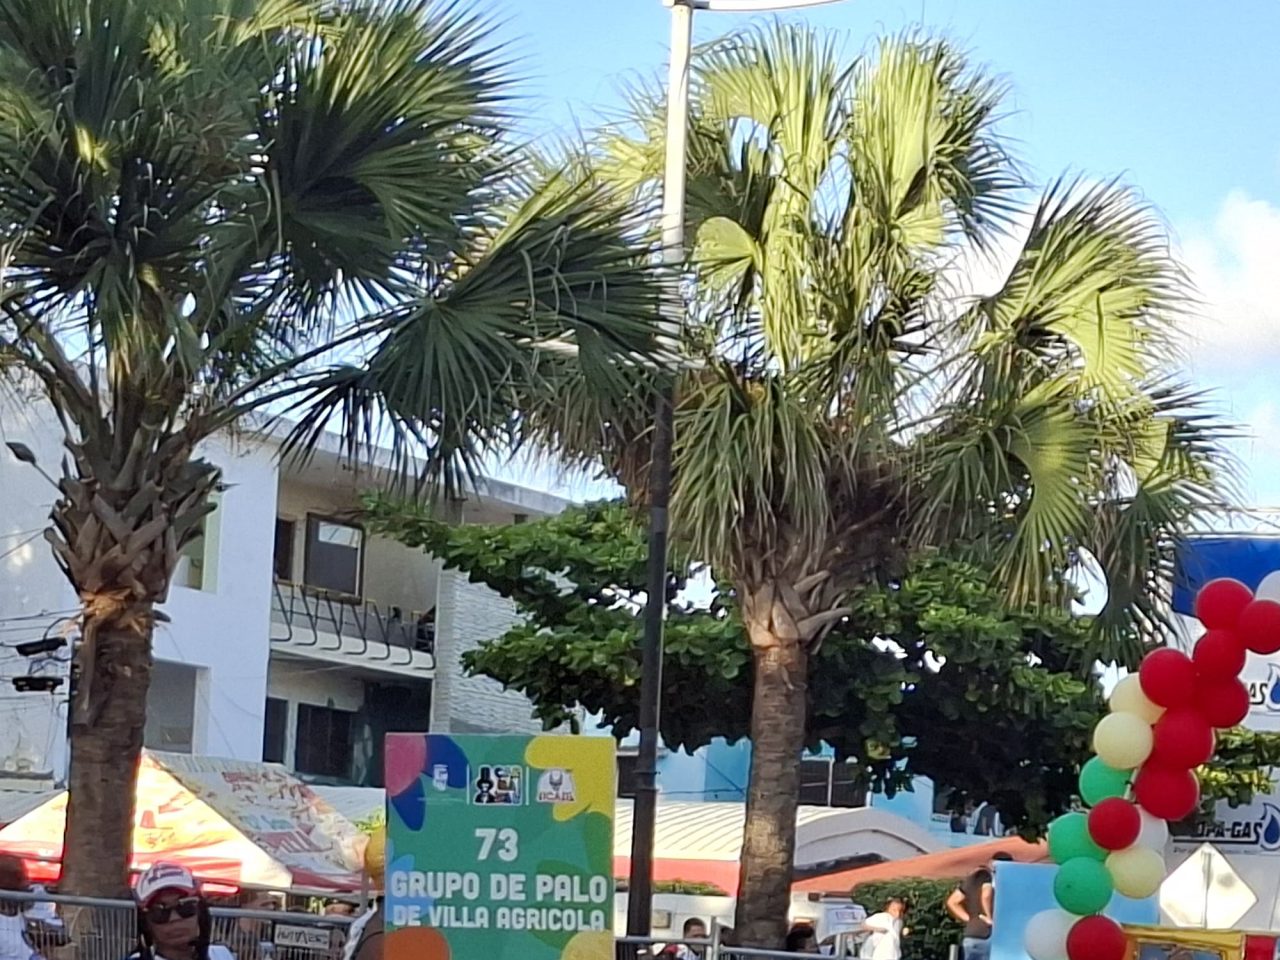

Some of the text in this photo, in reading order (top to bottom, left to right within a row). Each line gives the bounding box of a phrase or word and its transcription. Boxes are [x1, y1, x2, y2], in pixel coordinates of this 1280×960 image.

[475, 828, 519, 862] 73
[390, 870, 608, 904] GRUPO DE PALO
[393, 904, 605, 932] DE VILLA AGRICOLA
